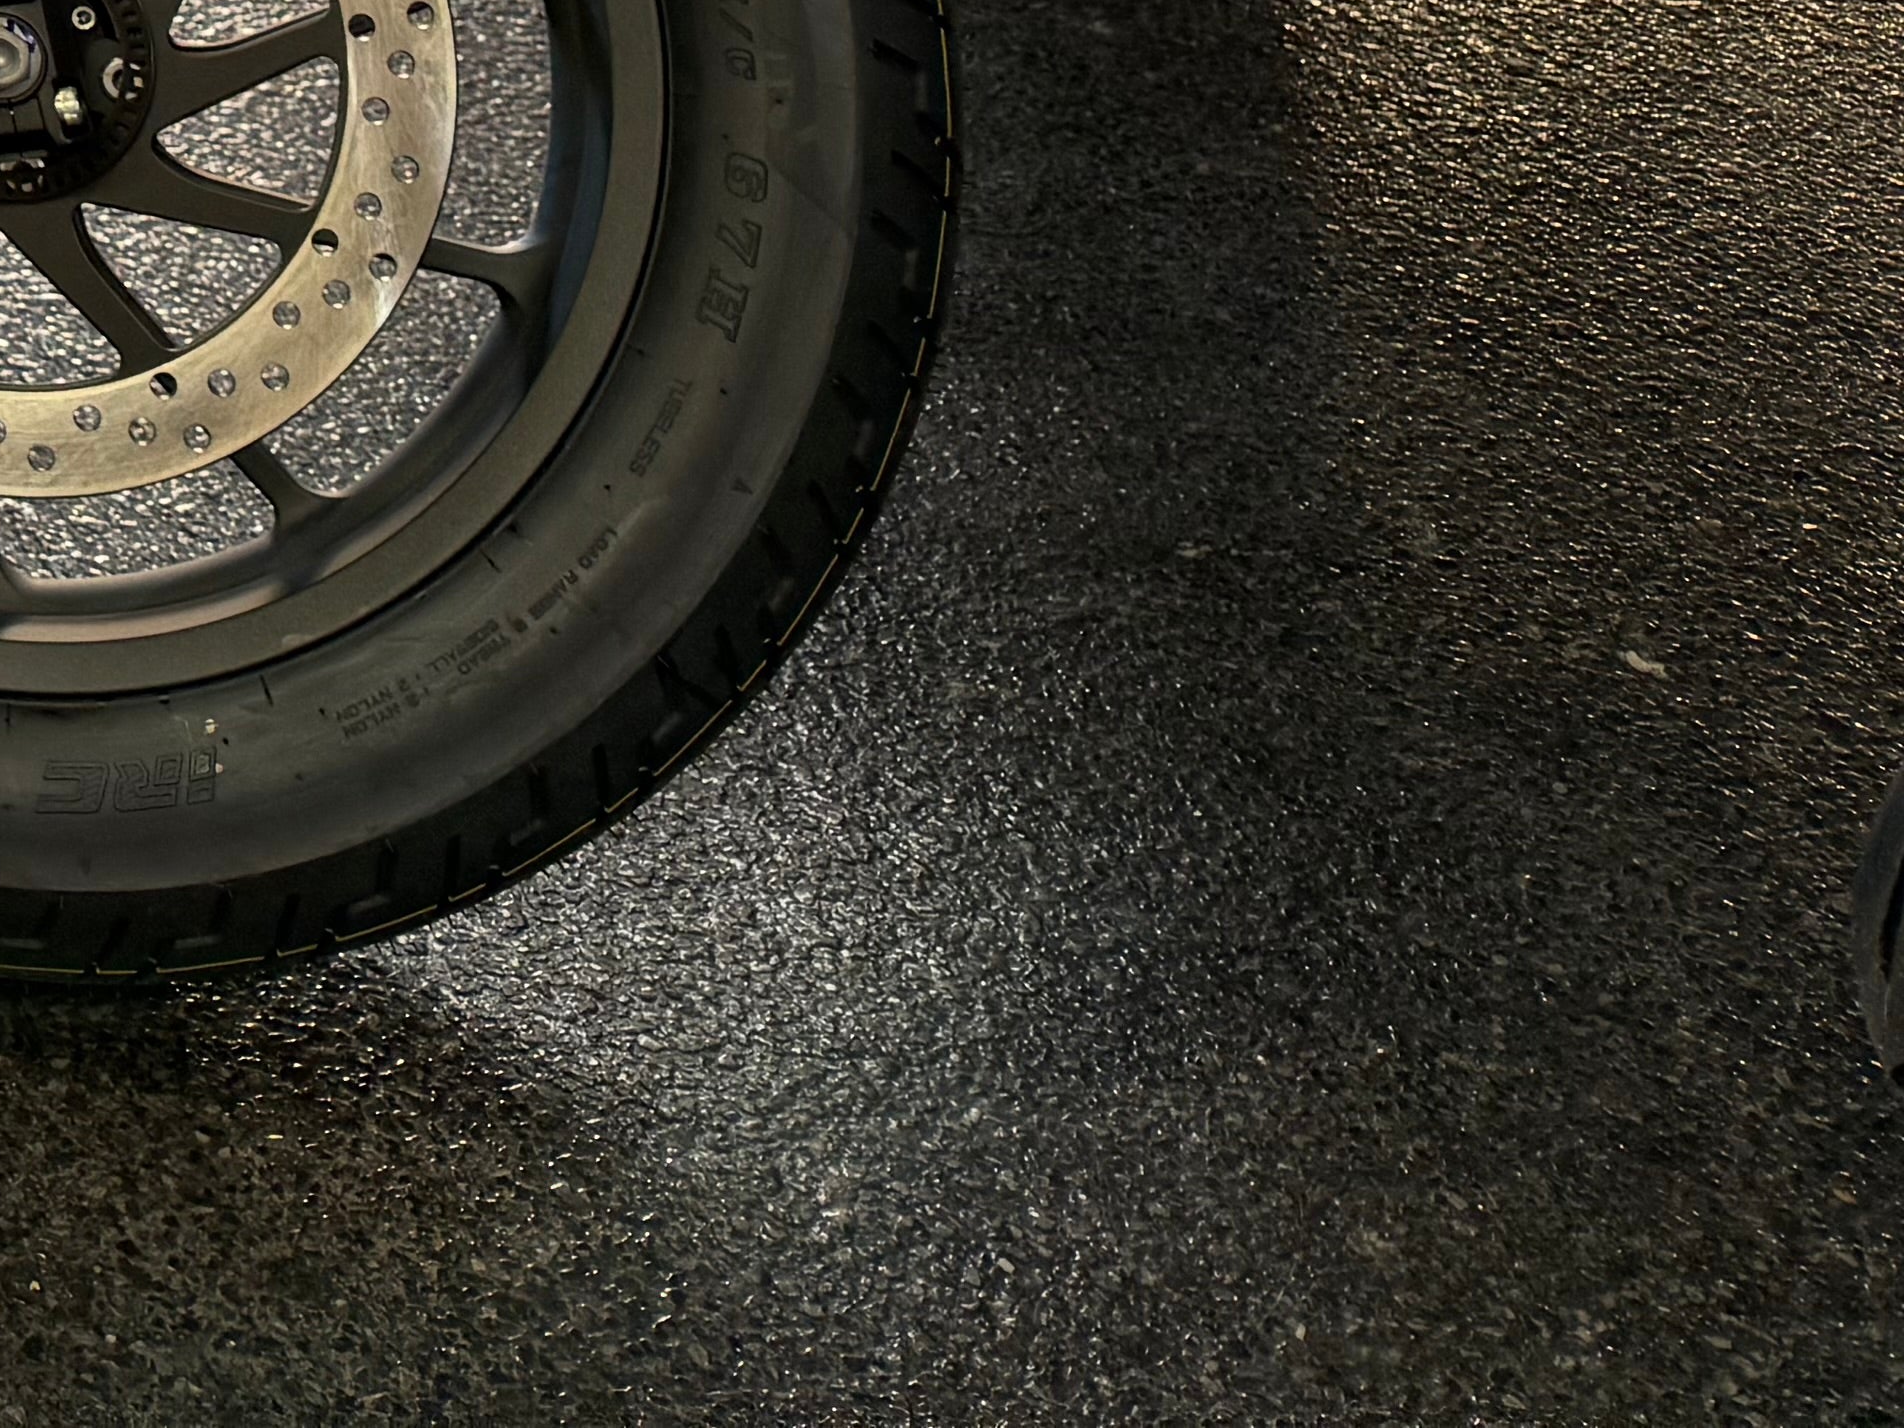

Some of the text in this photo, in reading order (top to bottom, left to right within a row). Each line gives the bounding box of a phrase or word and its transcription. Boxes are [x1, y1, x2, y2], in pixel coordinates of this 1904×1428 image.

[697, 152, 769, 344] 67H
[628, 377, 693, 478] TUBELESS
[577, 526, 618, 570] LOAD
